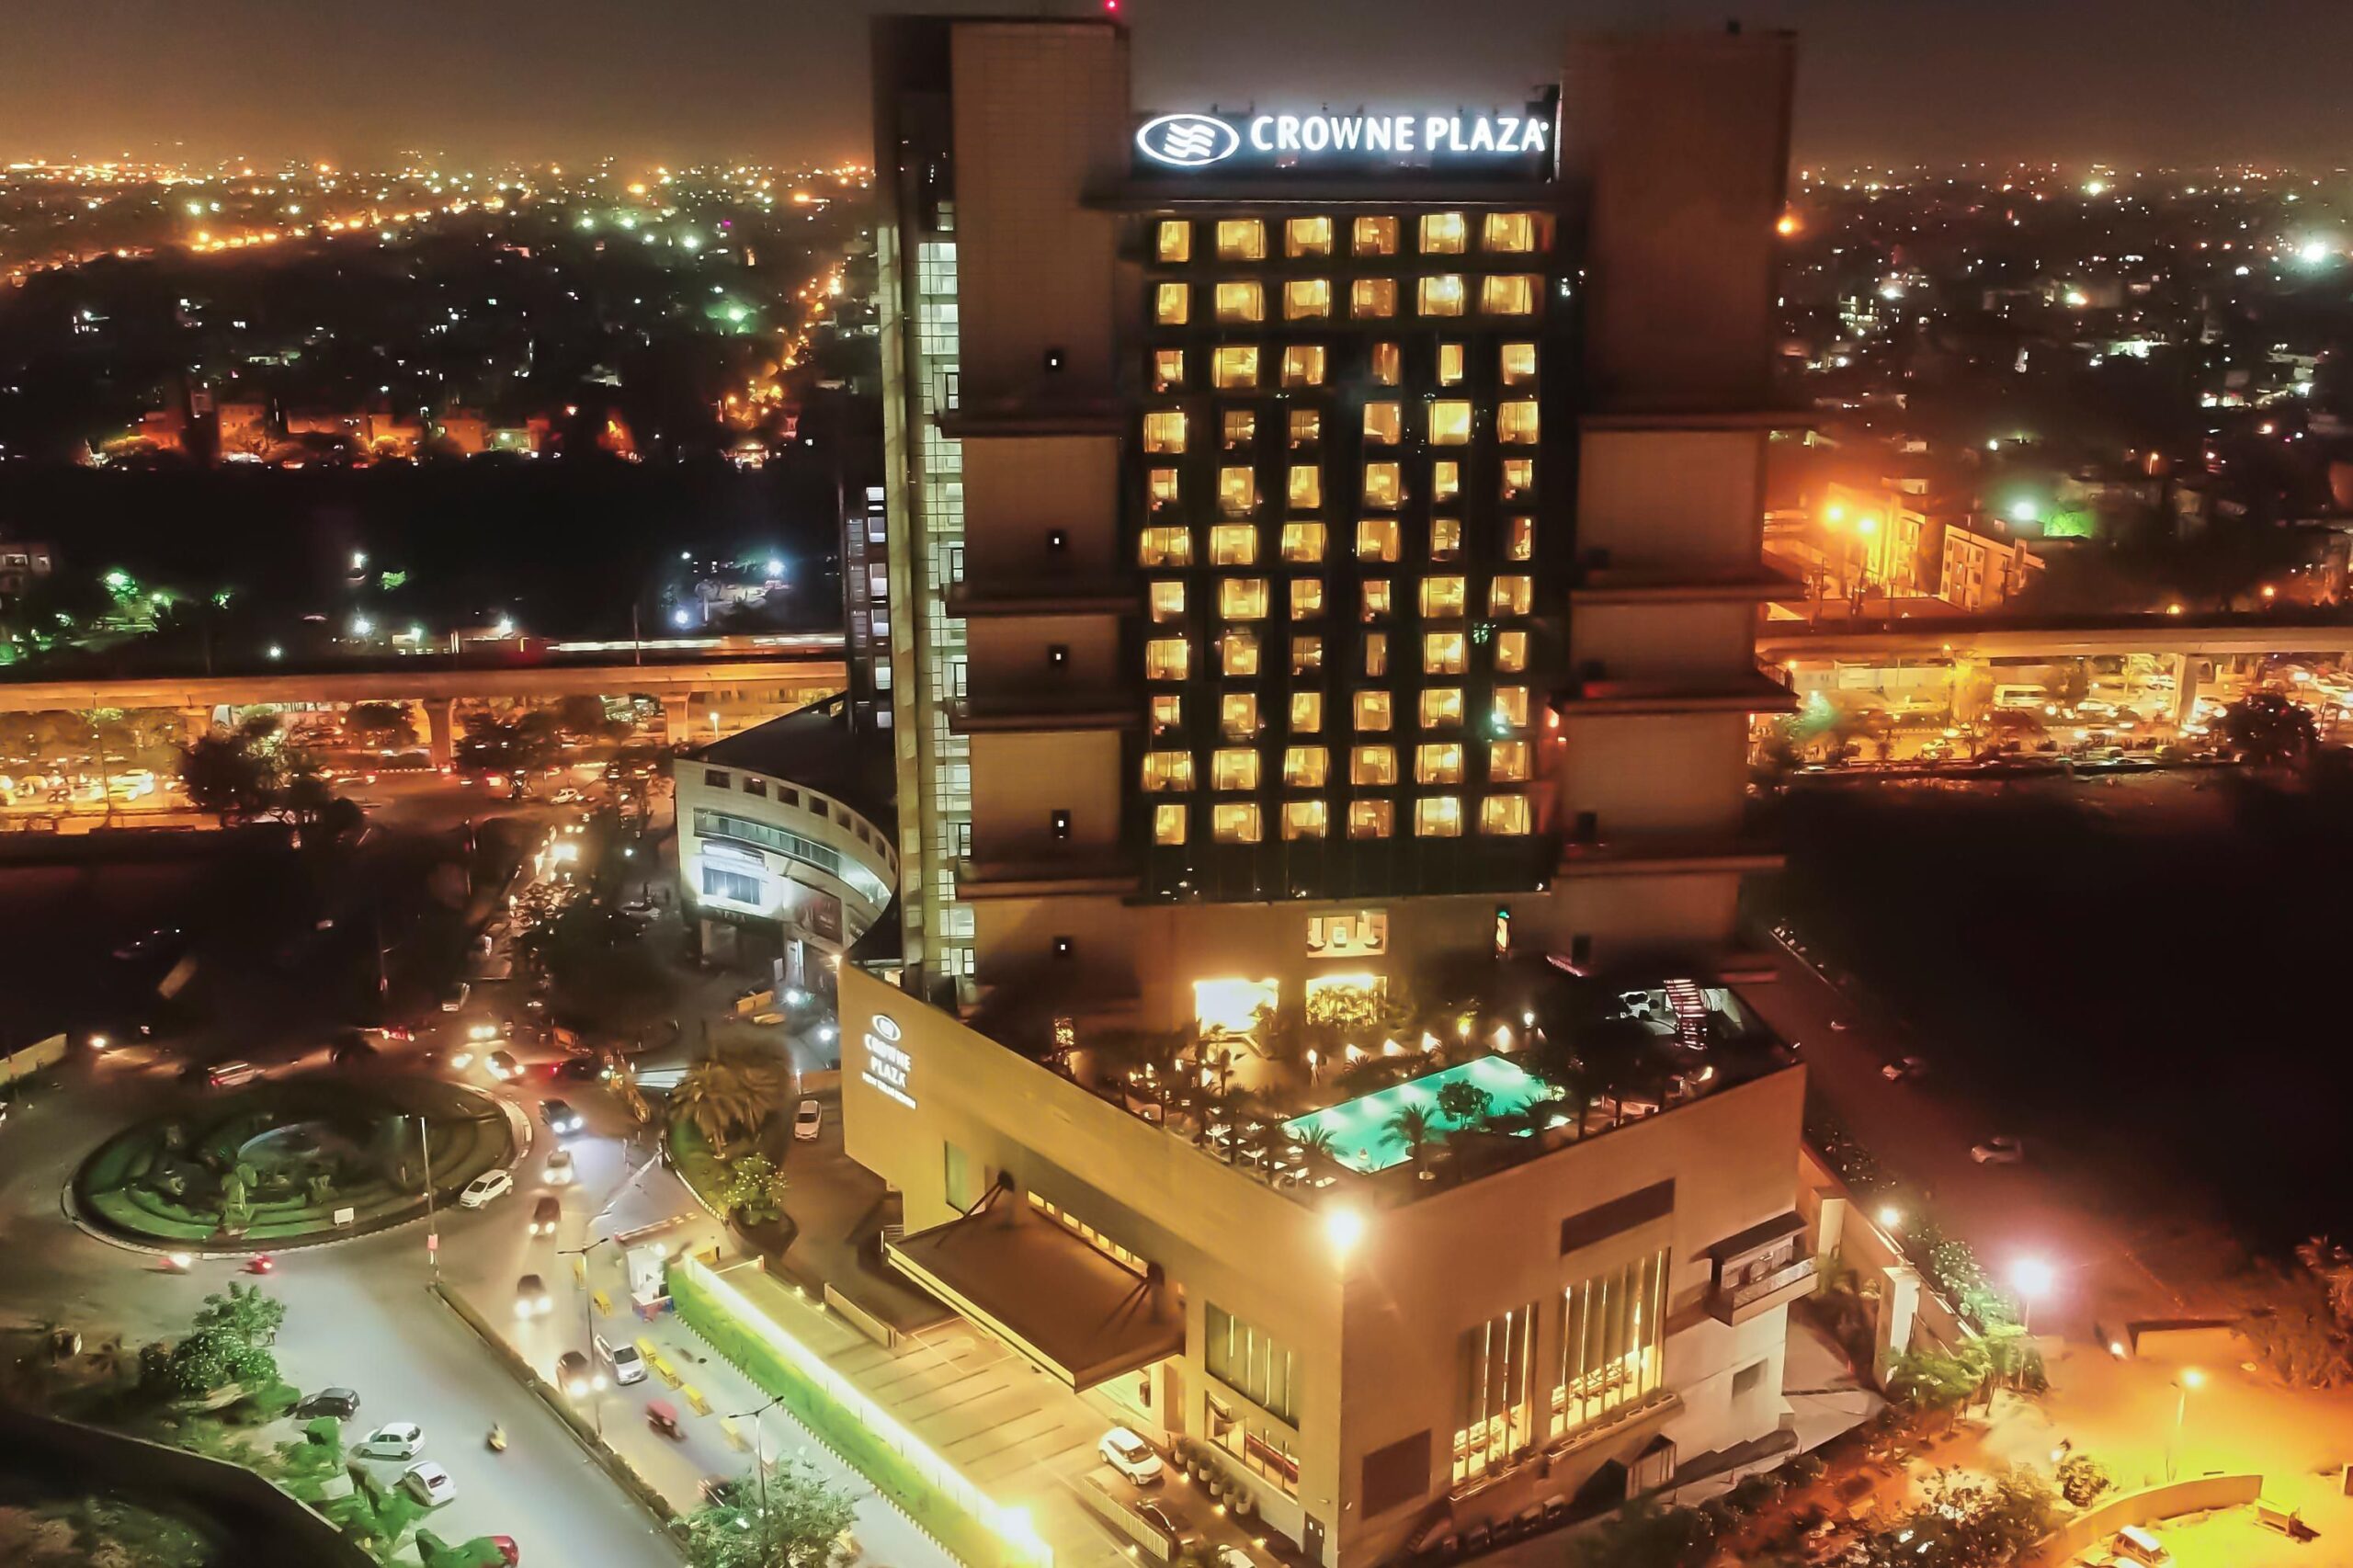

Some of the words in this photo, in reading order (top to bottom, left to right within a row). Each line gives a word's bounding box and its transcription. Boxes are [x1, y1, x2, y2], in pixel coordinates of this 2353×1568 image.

[1250, 115, 1415, 152] CROWNE
[1425, 116, 1547, 152] PLAZA
[870, 1055, 906, 1088] PLAZA
